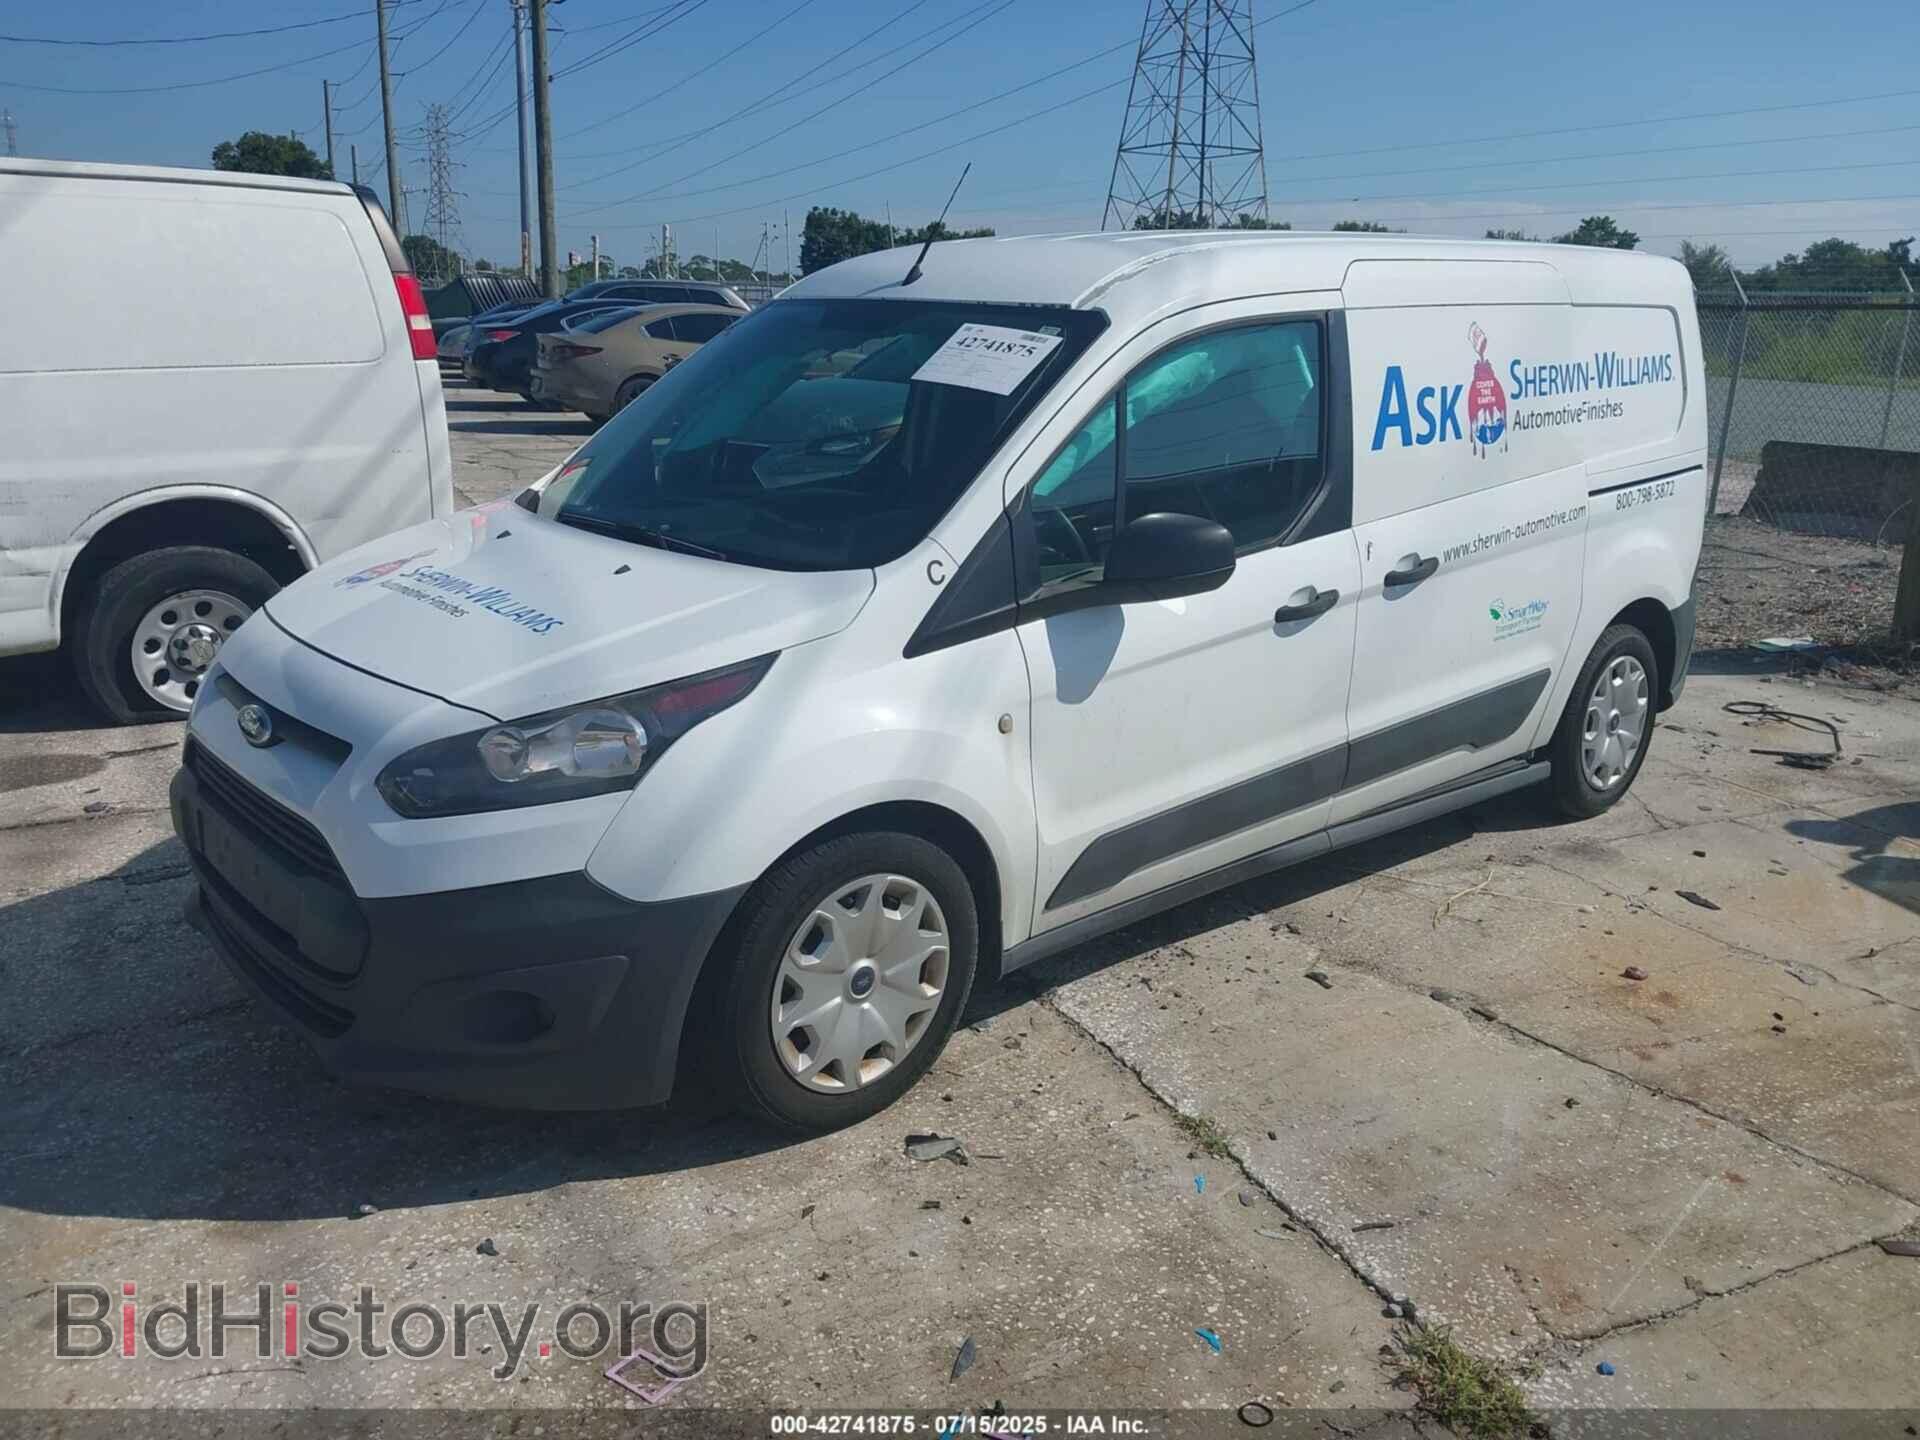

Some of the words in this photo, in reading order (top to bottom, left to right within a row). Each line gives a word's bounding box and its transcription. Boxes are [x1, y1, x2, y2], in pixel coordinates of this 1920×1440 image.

[956, 336, 1038, 358] 42741875
[1509, 351, 1673, 401] SHERWN-WILLIAMS
[1371, 365, 1464, 452] ASK
[1512, 403, 1582, 432] Automotive
[1615, 480, 1675, 511] 800-798-5872
[1442, 505, 1587, 563] www.sherwin-automotive.com
[926, 559, 946, 586] C
